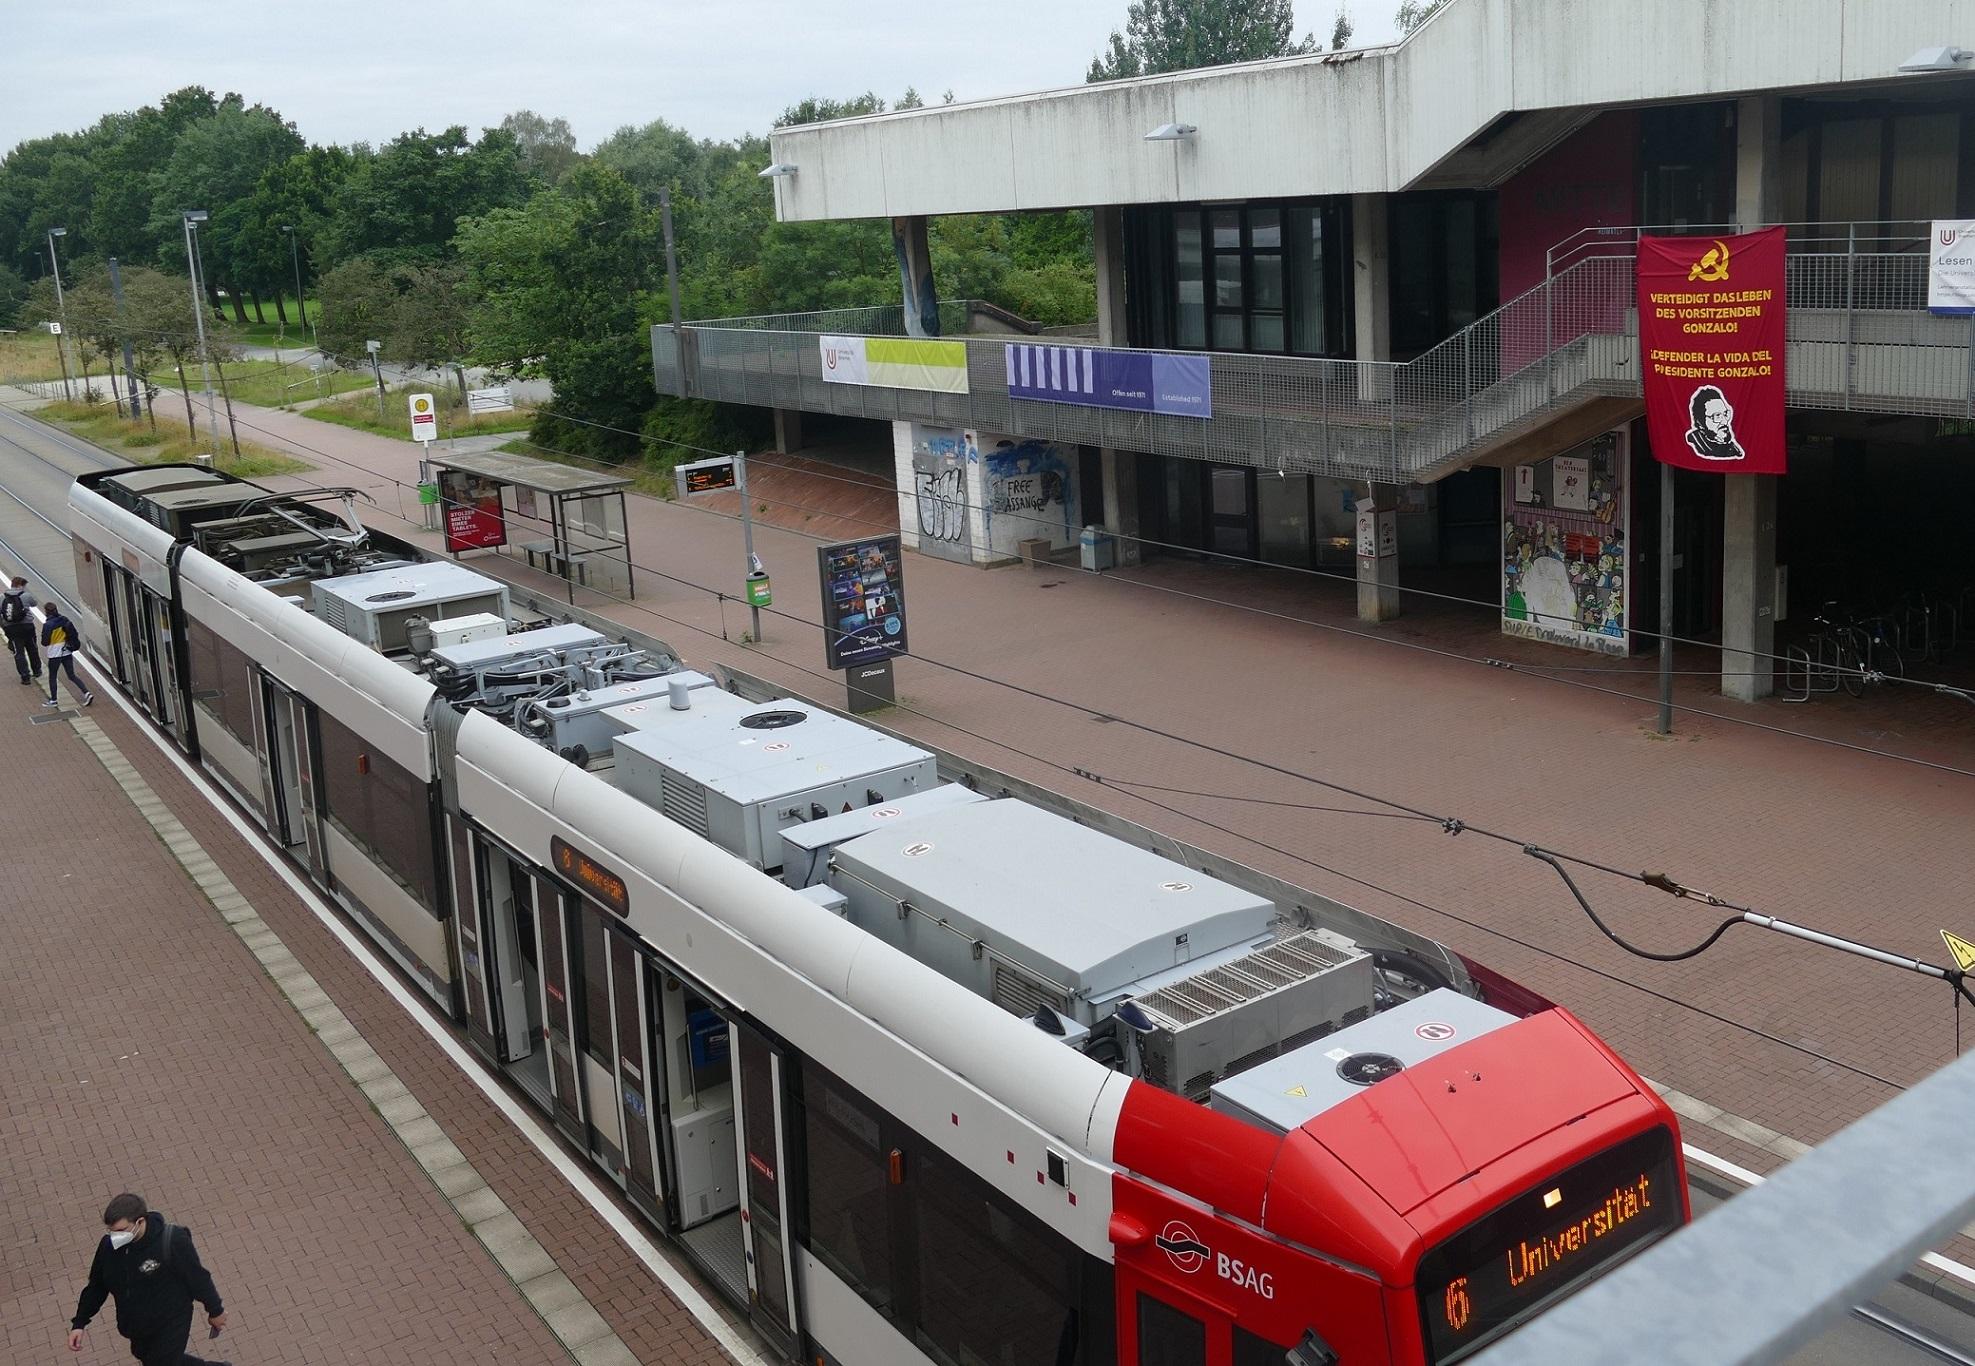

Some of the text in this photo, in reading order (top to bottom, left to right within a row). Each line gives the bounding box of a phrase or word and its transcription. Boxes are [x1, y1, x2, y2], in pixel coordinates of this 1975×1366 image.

[1939, 255, 1973, 266] Lesen
[1650, 289, 1772, 304] VERTEIDIGT DAS LEBEN
[1656, 305, 1761, 319] DES VORSITZENDEN
[1683, 322, 1738, 333] GONZALO!
[1707, 353, 1721, 363] LA
[1723, 352, 1750, 363] VIDA
[1752, 350, 1772, 361] DEL
[1717, 365, 1771, 378] GONZALO!
[1007, 480, 1033, 496] FREE
[1004, 495, 1045, 512] ASSANGE
[1446, 1174, 1650, 1330] 6 Universität
[1217, 1252, 1273, 1299] BSAG
